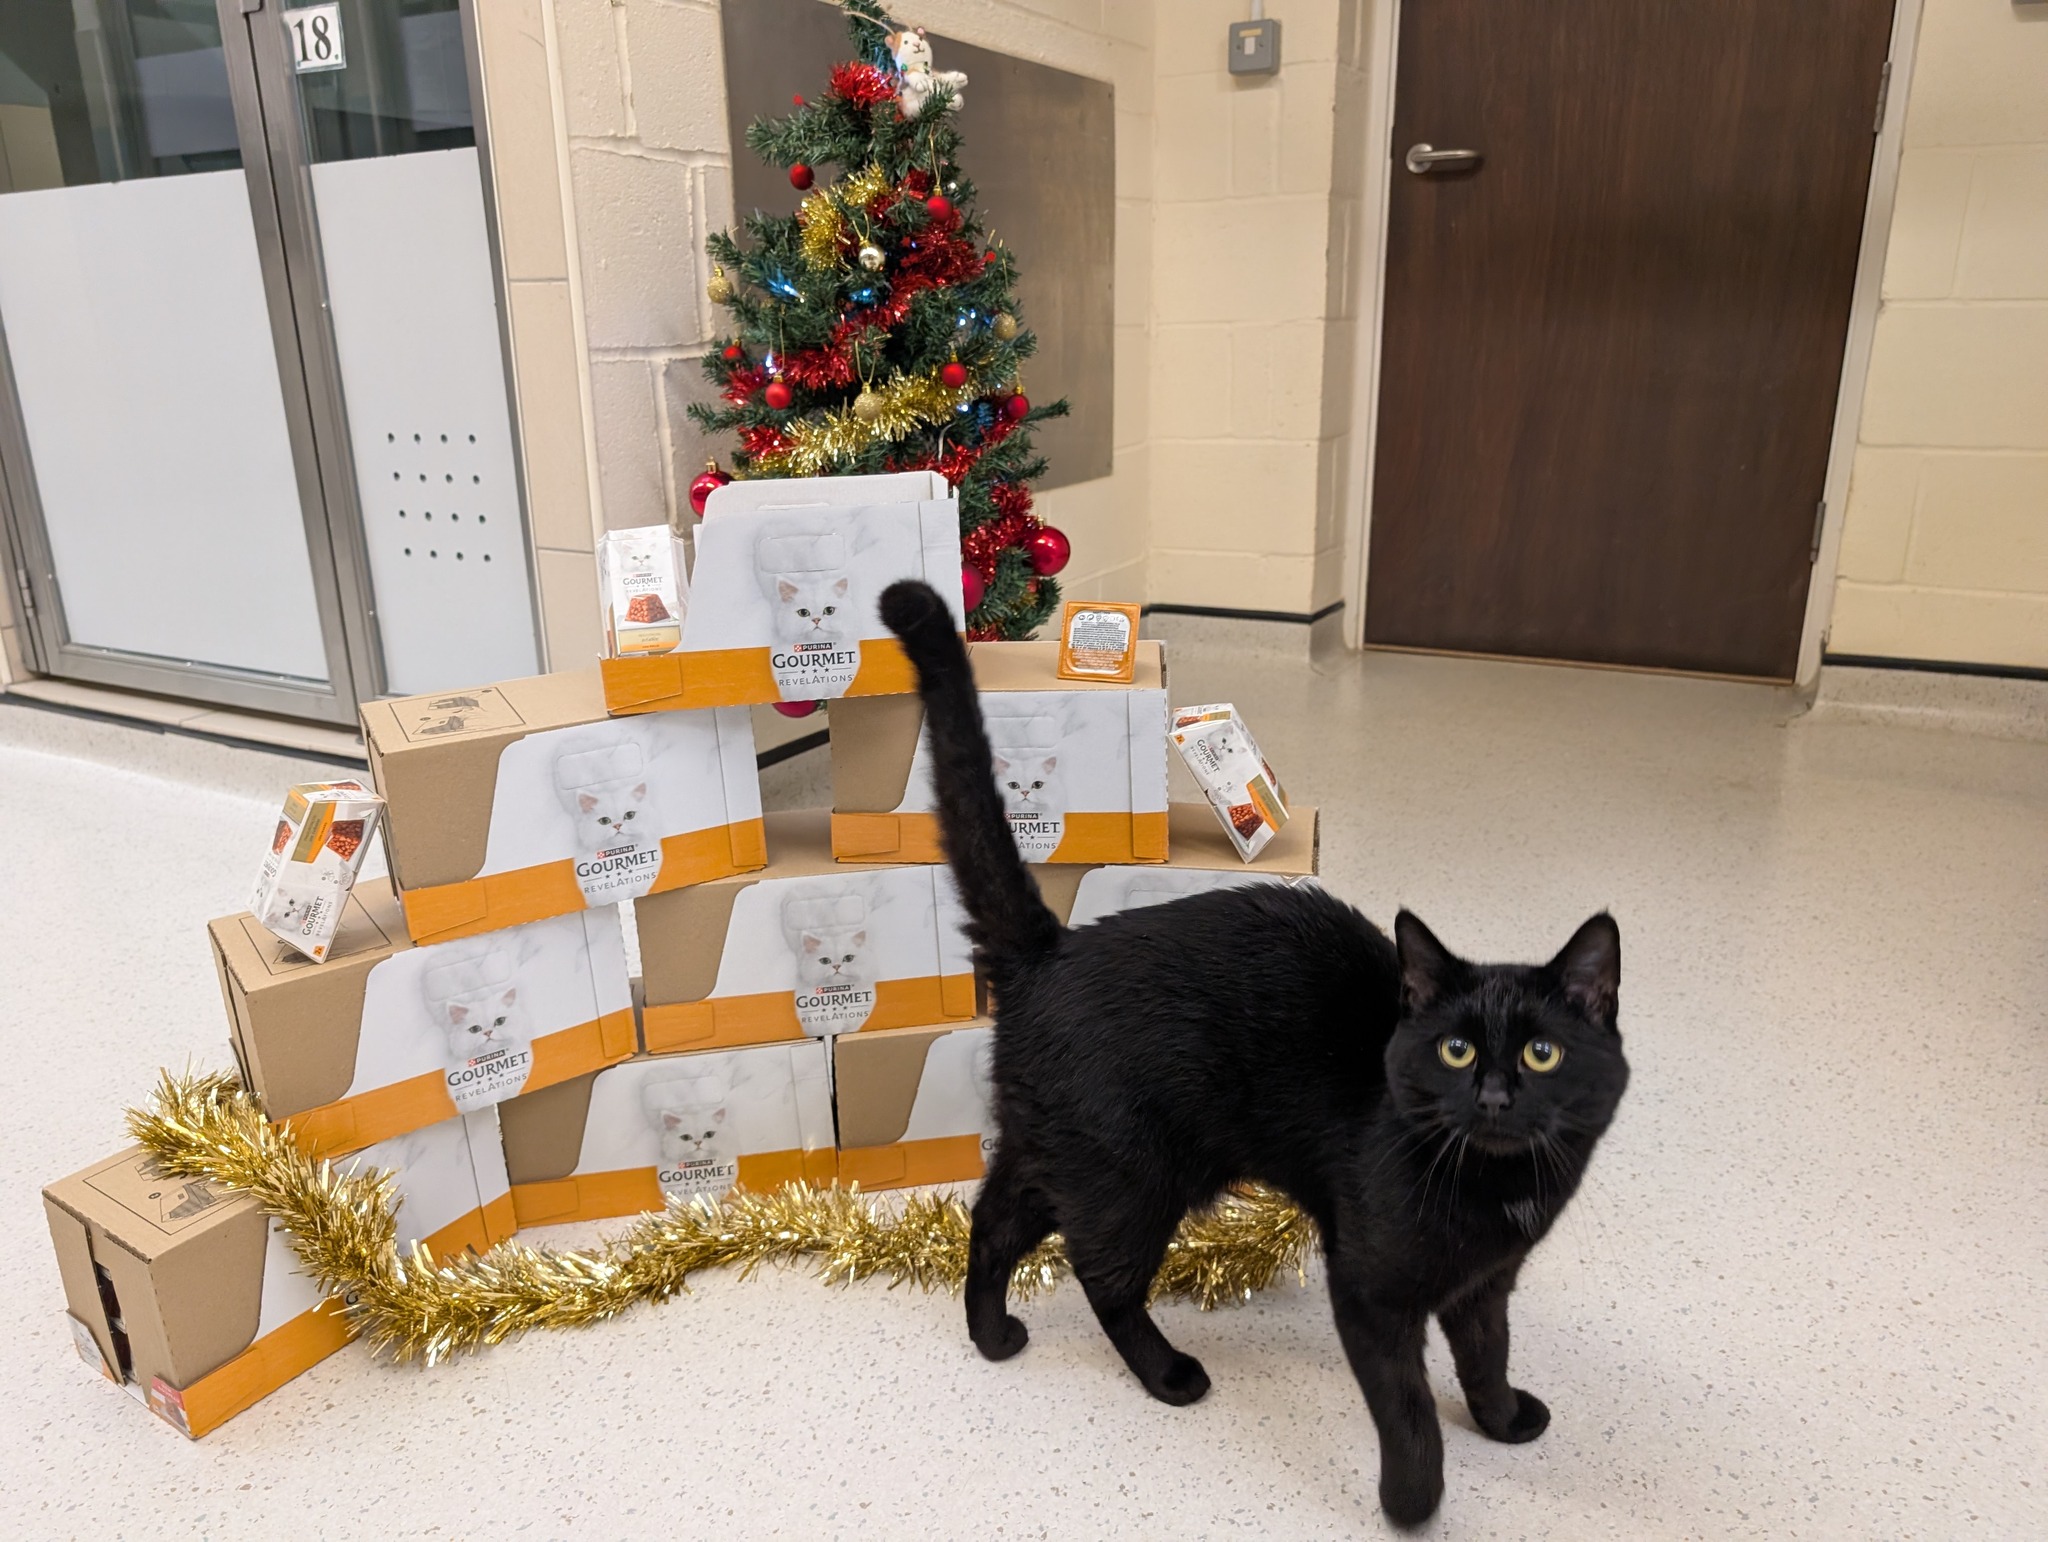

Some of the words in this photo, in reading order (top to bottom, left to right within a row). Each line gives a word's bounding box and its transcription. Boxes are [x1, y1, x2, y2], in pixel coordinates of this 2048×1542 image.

[293, 15, 332, 61] 18
[623, 577, 663, 585] GOURMET
[802, 643, 832, 651] PURINA
[772, 651, 856, 668] GOURMET
[779, 674, 853, 686] REVELATIONS
[1197, 739, 1220, 772] GOURMET
[1009, 822, 1060, 835] URMET
[605, 845, 634, 856] PURINA
[1018, 841, 1057, 849] ATIONS
[577, 850, 658, 877] GOURMET
[584, 872, 656, 893] REVELATIONS
[302, 896, 324, 936] GOURMET
[796, 991, 872, 1008] GOURMET
[801, 1011, 869, 1023] REVELATIONS
[476, 1050, 504, 1063] PURINA
[447, 1051, 528, 1086] GOURMET
[455, 1073, 527, 1102] REVELATIONS
[659, 1165, 734, 1183] GOURMET
